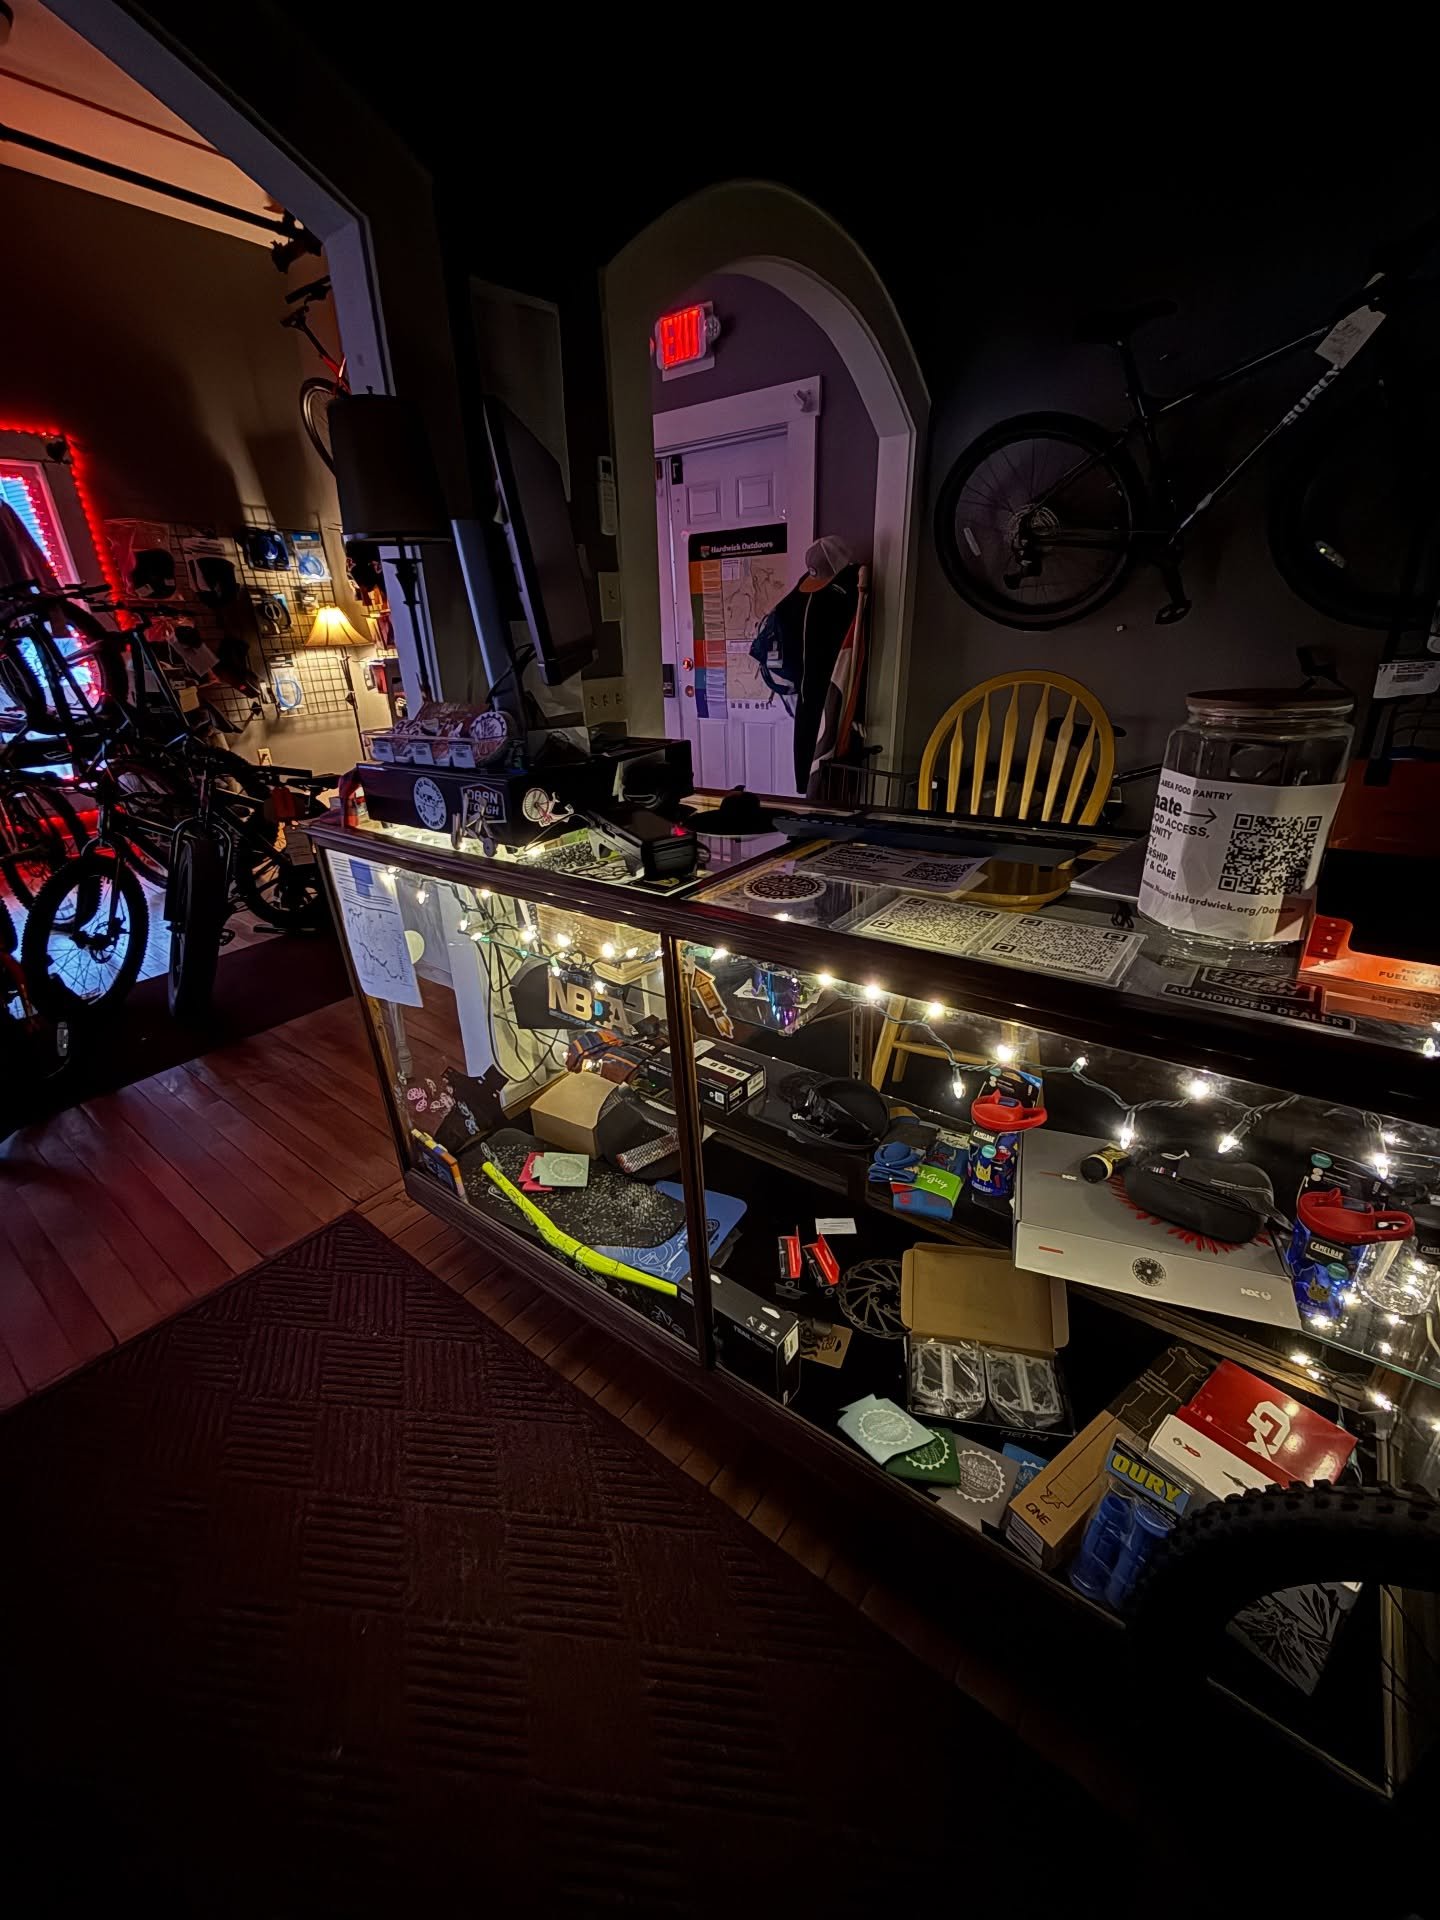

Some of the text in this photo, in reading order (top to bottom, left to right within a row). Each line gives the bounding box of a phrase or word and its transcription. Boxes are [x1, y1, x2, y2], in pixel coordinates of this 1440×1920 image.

[662, 309, 700, 365] EXIT
[711, 543, 741, 553] Hardwick
[741, 540, 774, 551] Outdoors
[1161, 780, 1233, 801] AREA FOOD PANTRY
[469, 801, 500, 816] TOGH
[1165, 818, 1210, 839] ACCESS,
[1156, 863, 1177, 881] CARE
[1378, 970, 1408, 981] FUEL
[1170, 986, 1272, 1012] AUTHORIZED
[1276, 1006, 1345, 1026] DEALER
[1310, 1241, 1345, 1260] CAMELBAK
[1111, 1455, 1183, 1503] OURY
